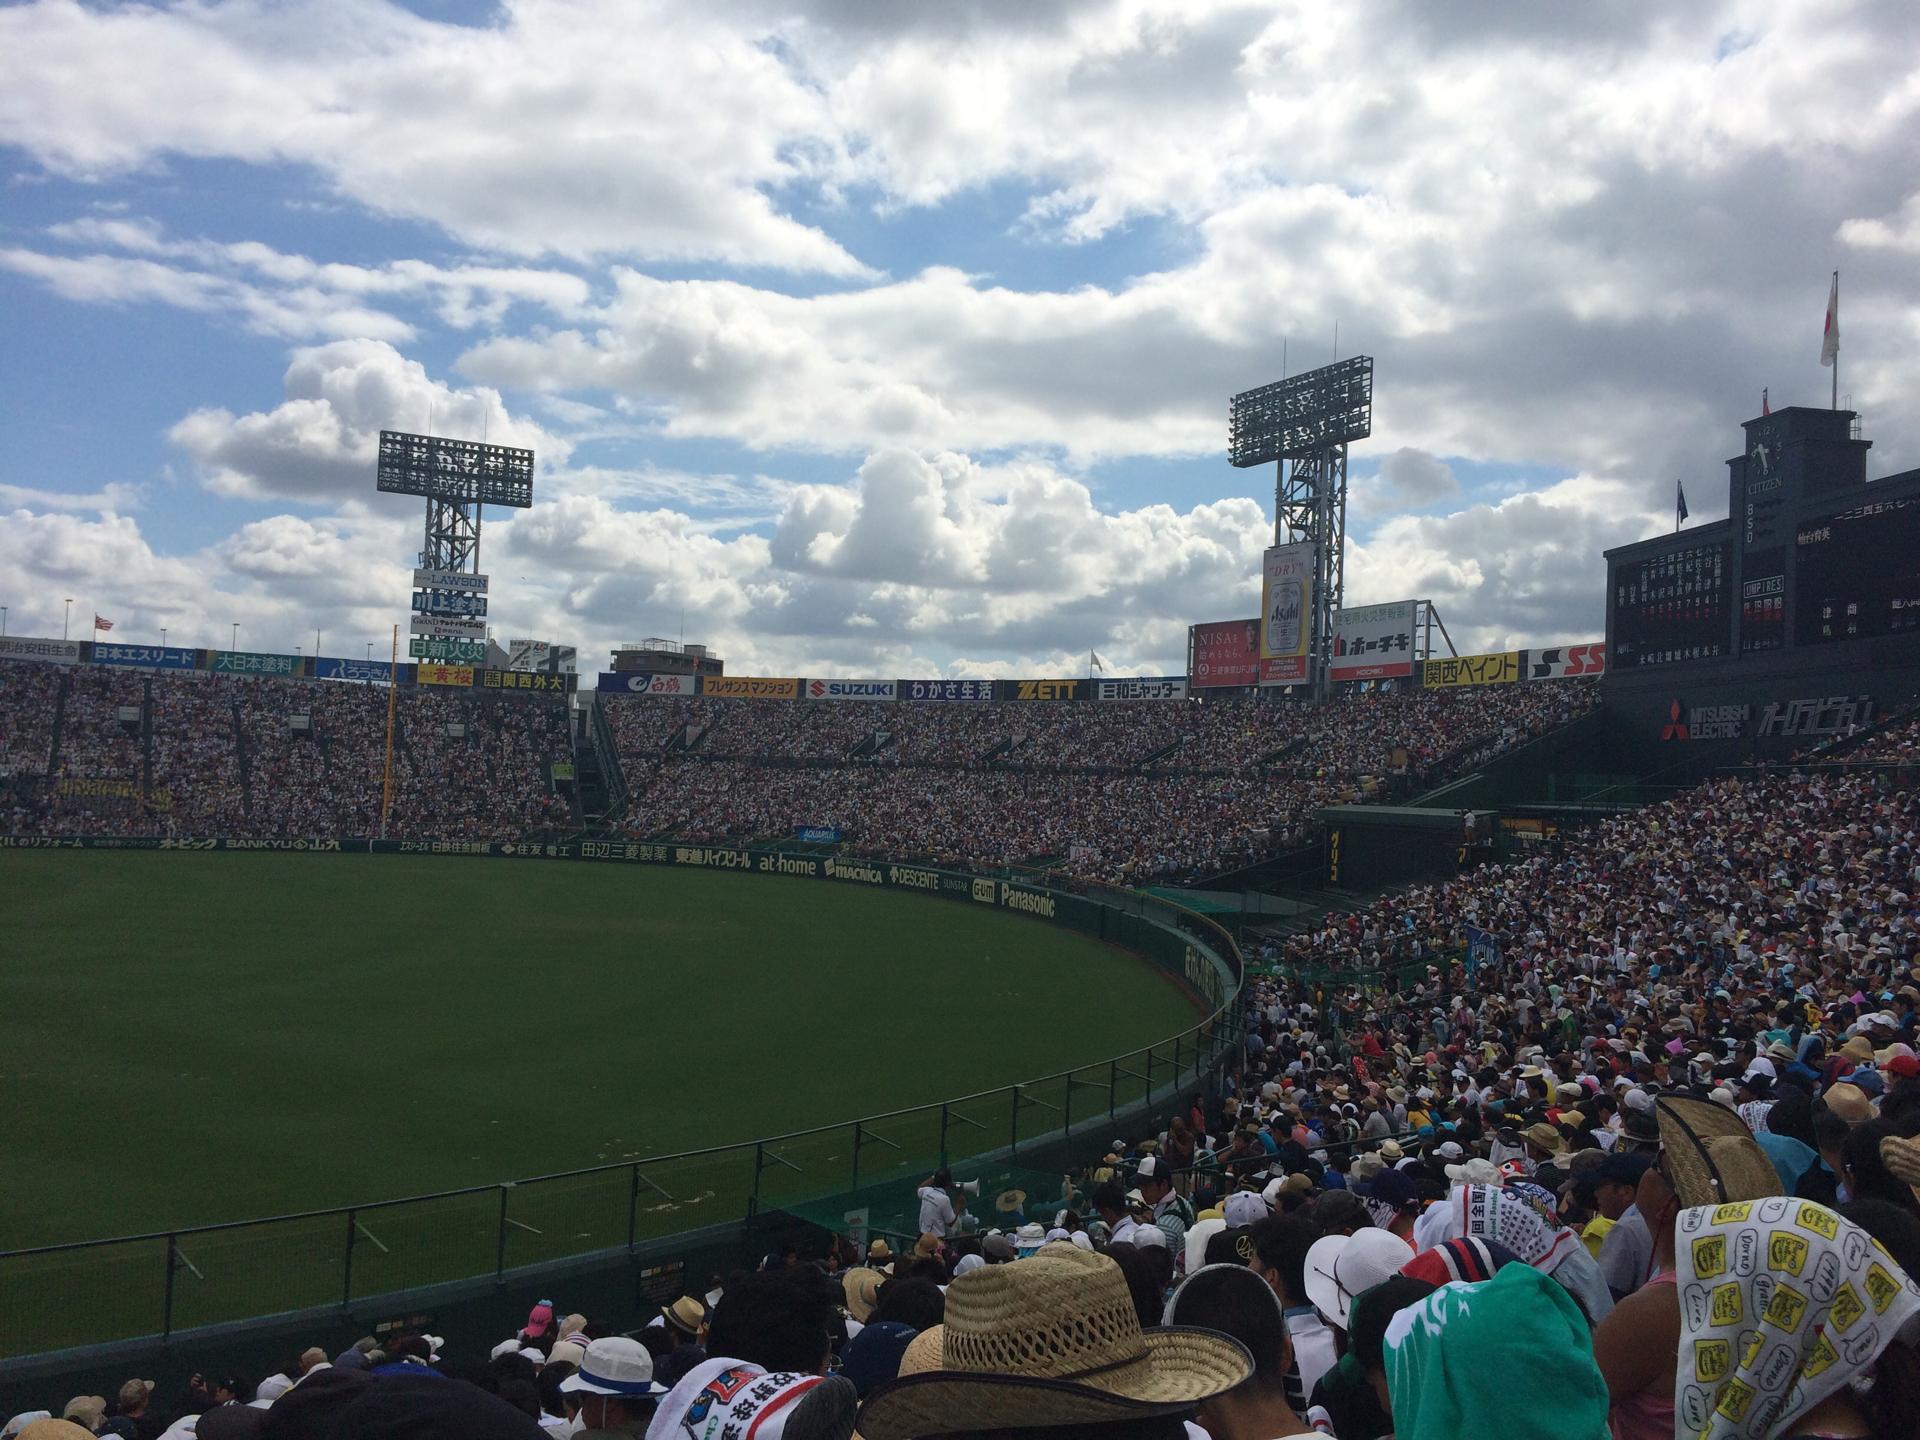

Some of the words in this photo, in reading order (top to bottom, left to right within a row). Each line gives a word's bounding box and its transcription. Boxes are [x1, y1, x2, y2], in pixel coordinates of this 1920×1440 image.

[1748, 477, 1783, 496] CITIZEN
[1747, 517, 1754, 529] S
[431, 575, 487, 588] LAWSON
[1746, 578, 1781, 595] UMPIRES
[415, 593, 486, 614] 川上塗料
[1271, 602, 1299, 622] Asahi
[412, 640, 485, 660] 日新火災
[1349, 634, 1410, 656] ホーチキ
[94, 647, 195, 666] 日本エスリード
[217, 653, 292, 673] 大日本塗料
[347, 667, 393, 681] ろうきん
[434, 667, 472, 685] 黄桜
[1425, 655, 1517, 685] 関西ペイント
[503, 672, 562, 690] 関西外大
[651, 675, 680, 693] 白鶴
[829, 683, 894, 696] SUZUKI
[911, 681, 993, 700] わかさ生活
[1017, 681, 1078, 700] ZETT
[1103, 682, 1181, 699] 三和シャッター
[1690, 704, 1749, 723] MITSUBISHI
[1690, 722, 1742, 739] ELECTRIC
[803, 828, 836, 839] AQUARIUS
[158, 838, 217, 851] オービック
[226, 838, 292, 849] SANKYU
[309, 838, 341, 851] 山九
[431, 841, 492, 854] 日鉄住金鋼板
[517, 843, 570, 857] 住友電工
[581, 842, 668, 863] 田辺三菱製薬
[675, 848, 752, 869] 東進ハイスクール
[760, 856, 775, 871] at
[778, 853, 817, 876] home
[898, 869, 939, 890] DESCENTE
[943, 878, 968, 892] SUNSTAR
[1001, 884, 1056, 918] Panasonic
[1739, 1235, 1753, 1270] Porno
[1765, 1350, 1791, 1386] Porno
